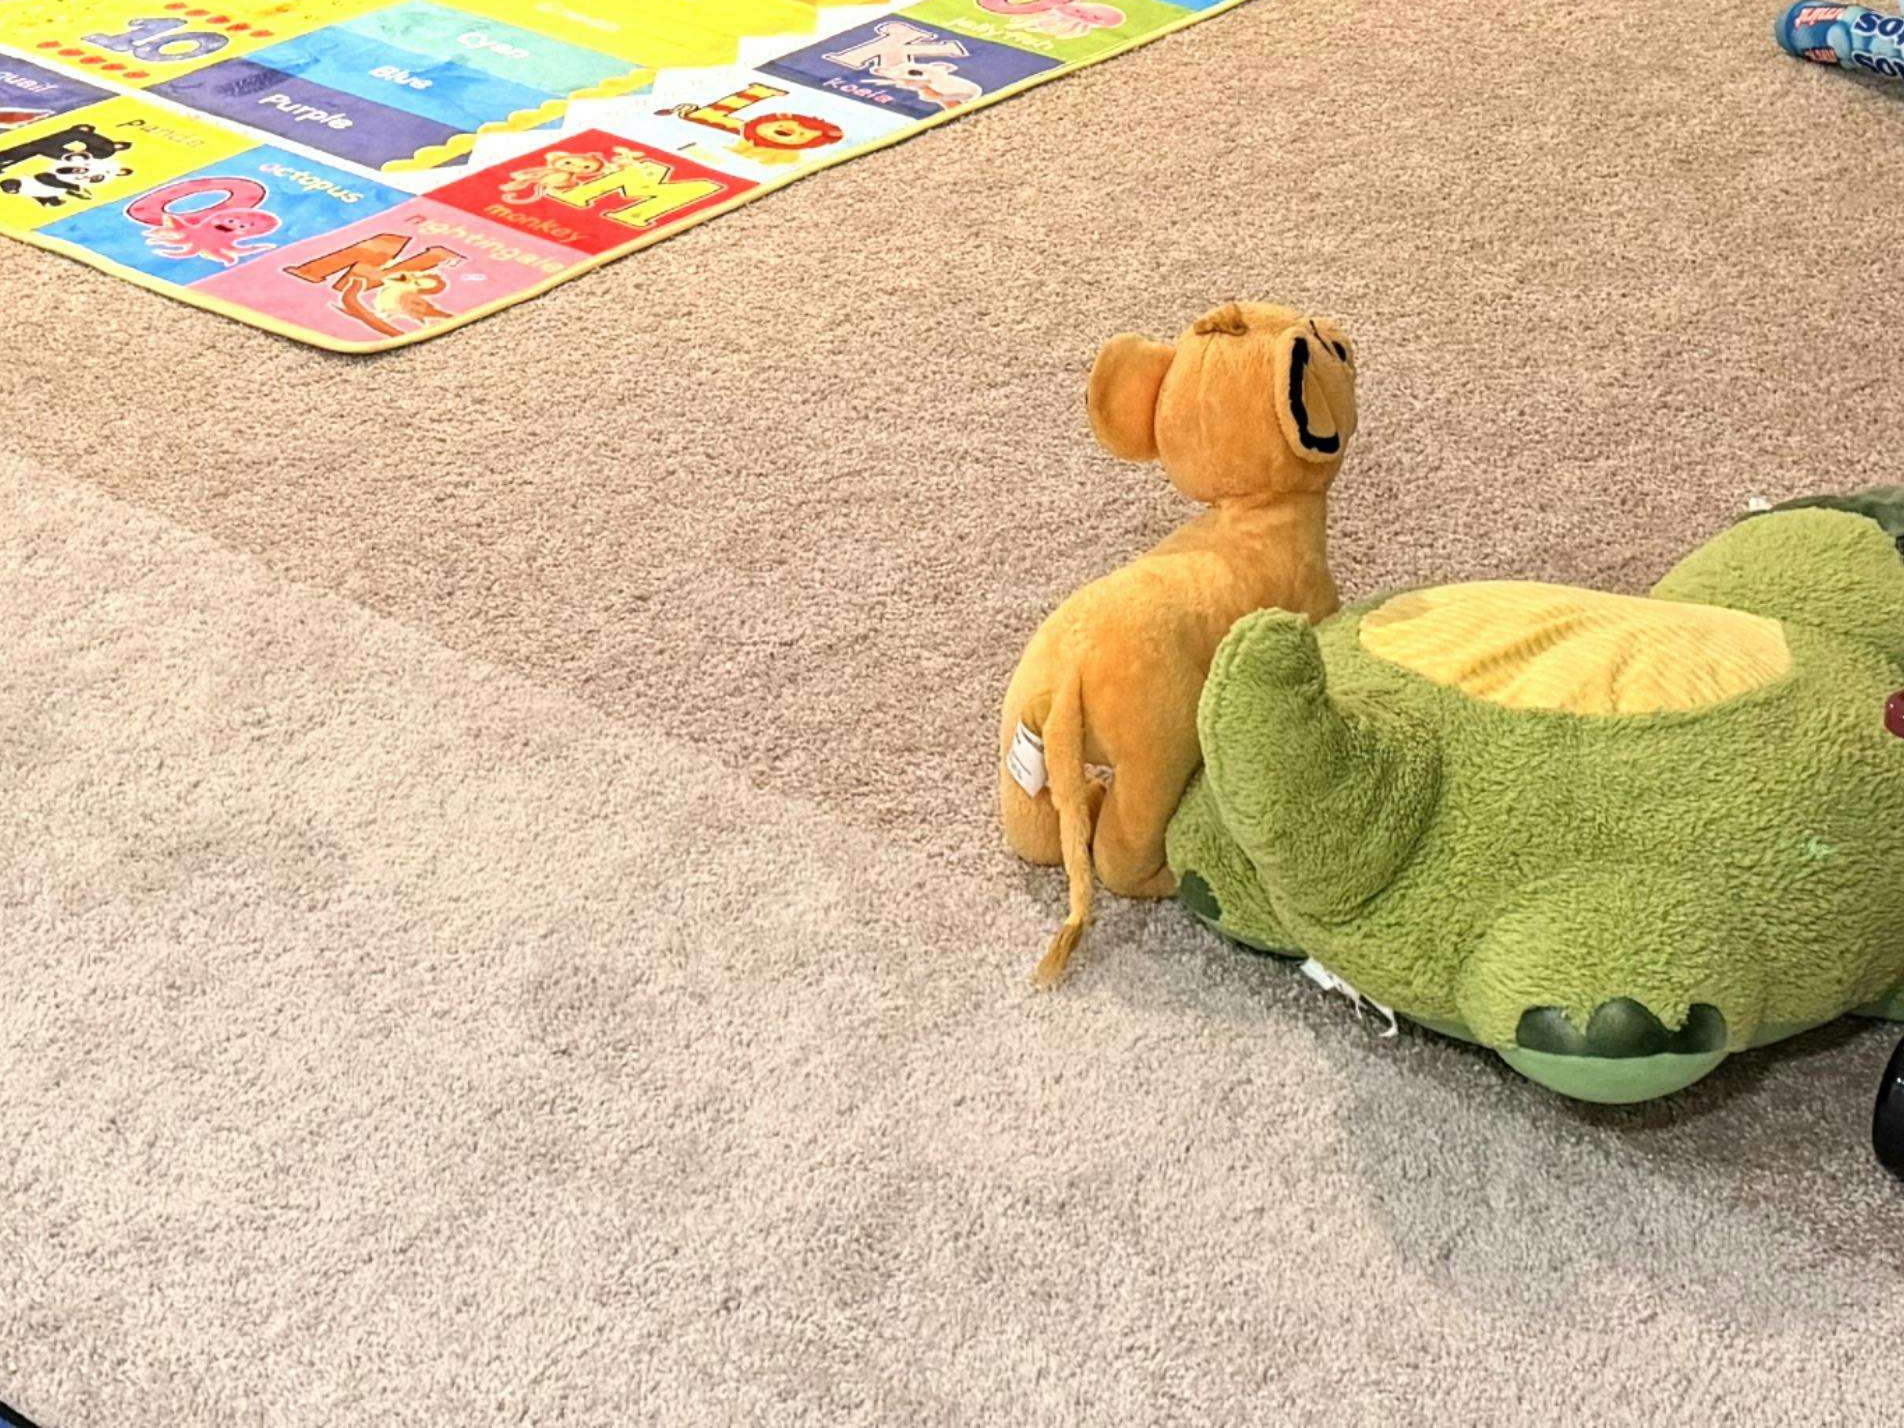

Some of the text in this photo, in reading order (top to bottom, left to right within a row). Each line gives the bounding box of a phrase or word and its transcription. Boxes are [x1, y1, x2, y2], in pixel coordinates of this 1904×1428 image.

[80, 17, 229, 62] 10
[820, 19, 970, 73] K
[369, 65, 434, 91] Blue
[822, 75, 895, 105] koala
[116, 117, 207, 150] panda
[259, 91, 356, 131] Purple
[259, 159, 366, 205] octopus
[548, 158, 728, 229] M
[403, 211, 567, 274] nightingale
[482, 201, 589, 245] monkey
[281, 232, 469, 292] N
